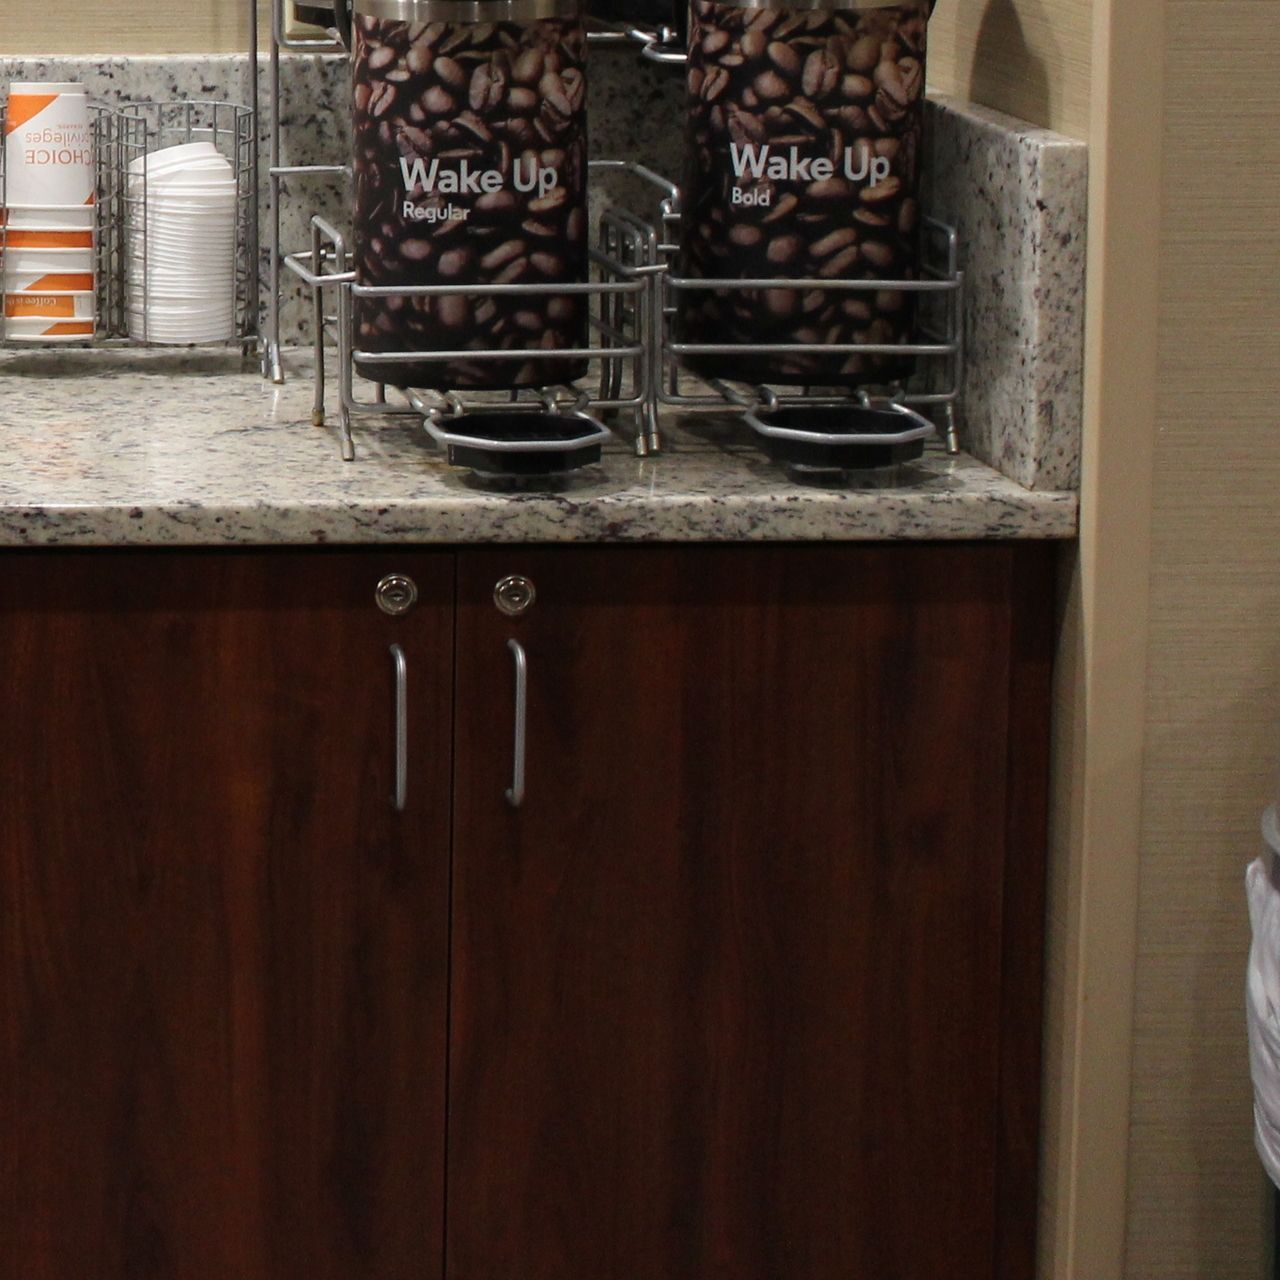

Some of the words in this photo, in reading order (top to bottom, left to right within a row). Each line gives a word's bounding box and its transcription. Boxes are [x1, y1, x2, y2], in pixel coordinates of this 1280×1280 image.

[25, 149, 90, 166] CHOICE
[730, 142, 834, 181] Wake
[844, 146, 890, 187] Up
[399, 157, 505, 193] Wake
[513, 158, 558, 198] Up
[732, 186, 771, 207] Bold
[403, 201, 471, 223] Regular
